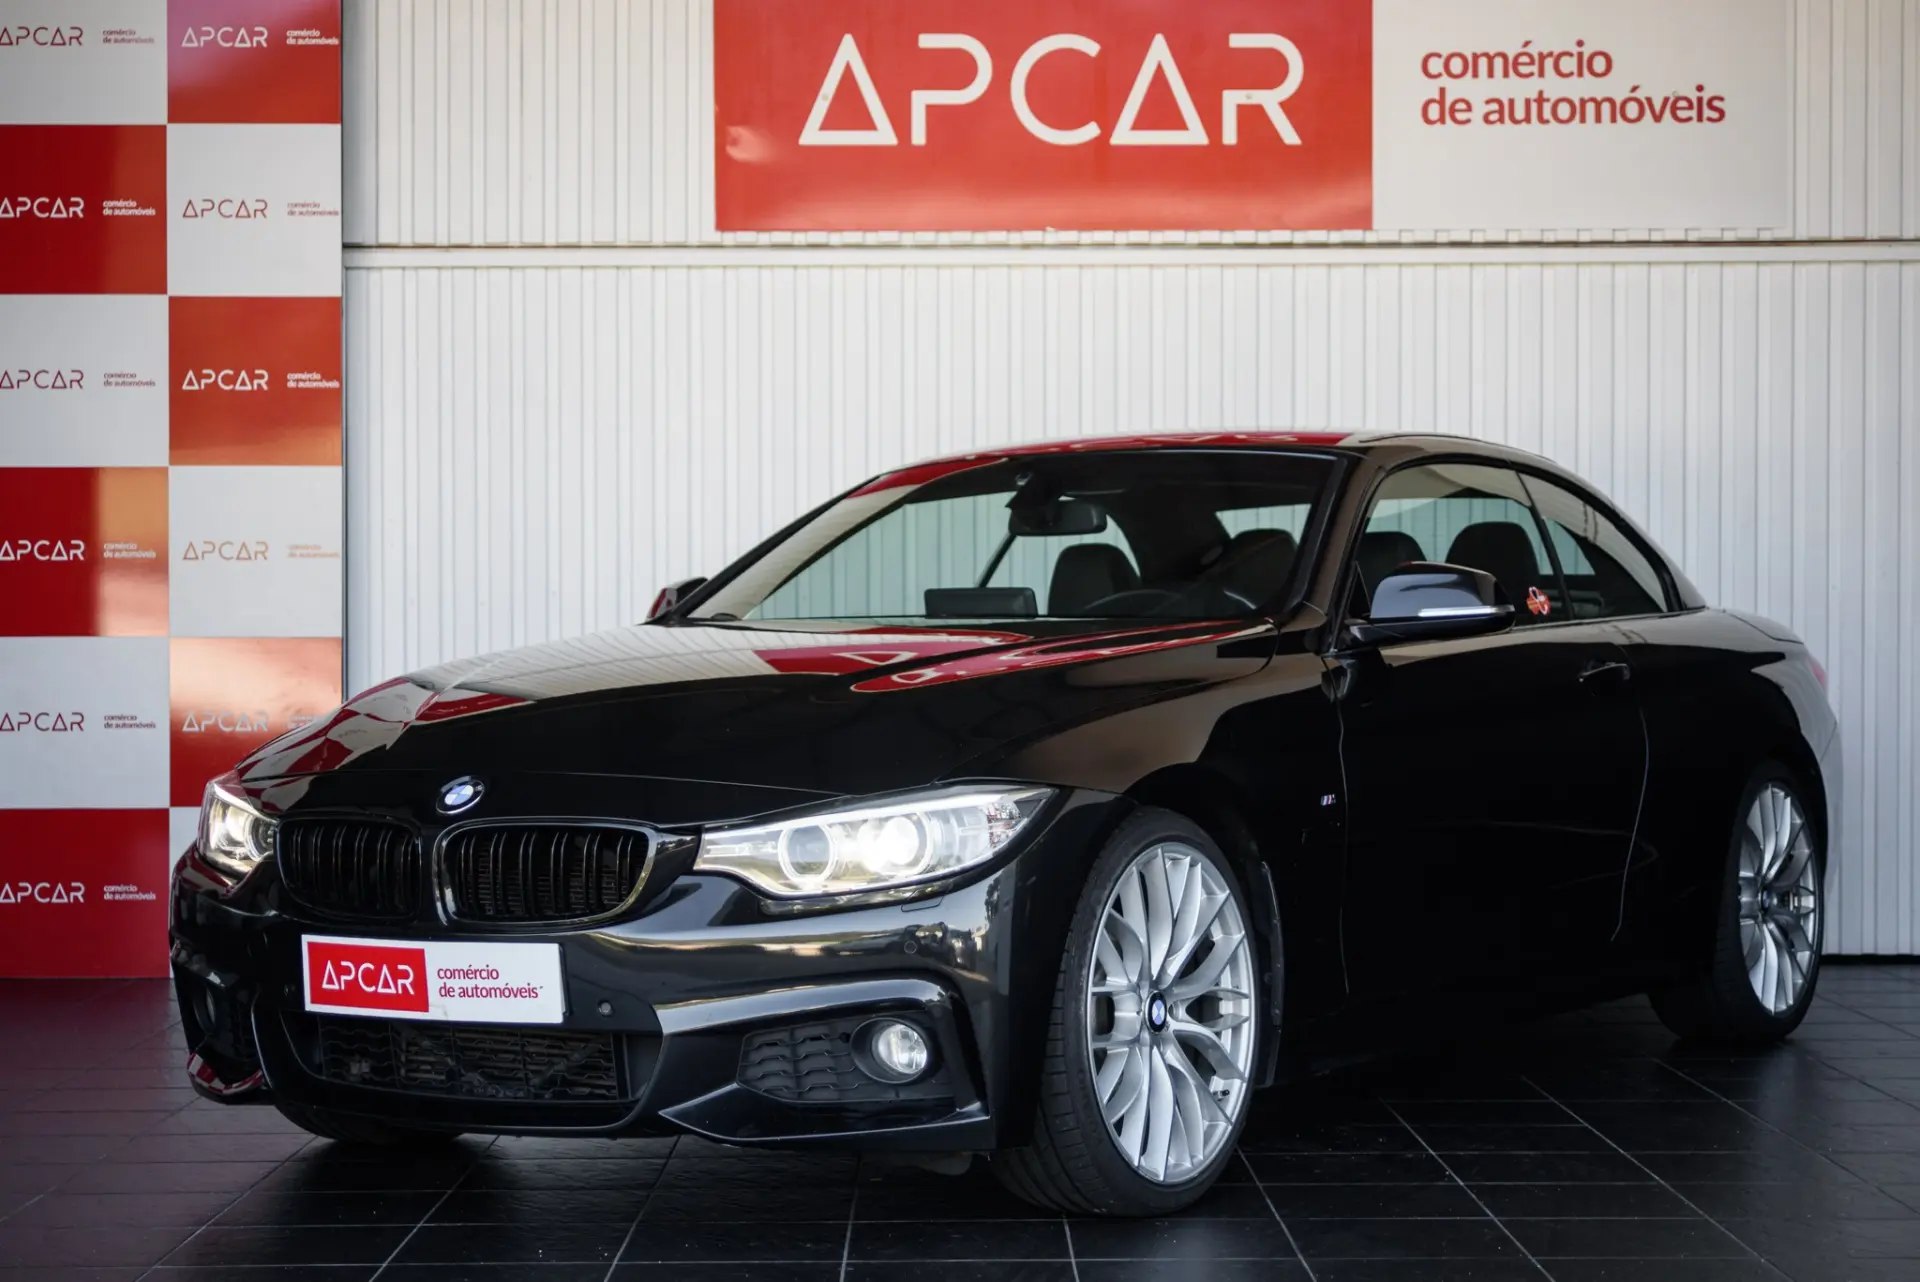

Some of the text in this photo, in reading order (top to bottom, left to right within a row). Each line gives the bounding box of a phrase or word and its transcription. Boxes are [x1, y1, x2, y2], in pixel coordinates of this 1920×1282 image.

[0, 26, 83, 46] APCAR
[182, 27, 268, 48] APCAR
[1421, 39, 1614, 80] comércio
[798, 32, 1304, 146] APCAR
[1420, 83, 1726, 125] de automóveis
[0, 197, 84, 218] APCAR
[182, 199, 268, 219] APCAR
[0, 369, 84, 389] APCAR
[182, 369, 269, 391] APCAR
[0, 540, 85, 561] APCAR
[182, 541, 269, 561] APCAR
[0, 712, 84, 732] APCAR
[182, 711, 269, 733] APCAR
[0, 882, 85, 903] APCAR
[321, 959, 415, 995] APCAR
[437, 964, 500, 981] comércio
[439, 981, 539, 999] de automóveis
